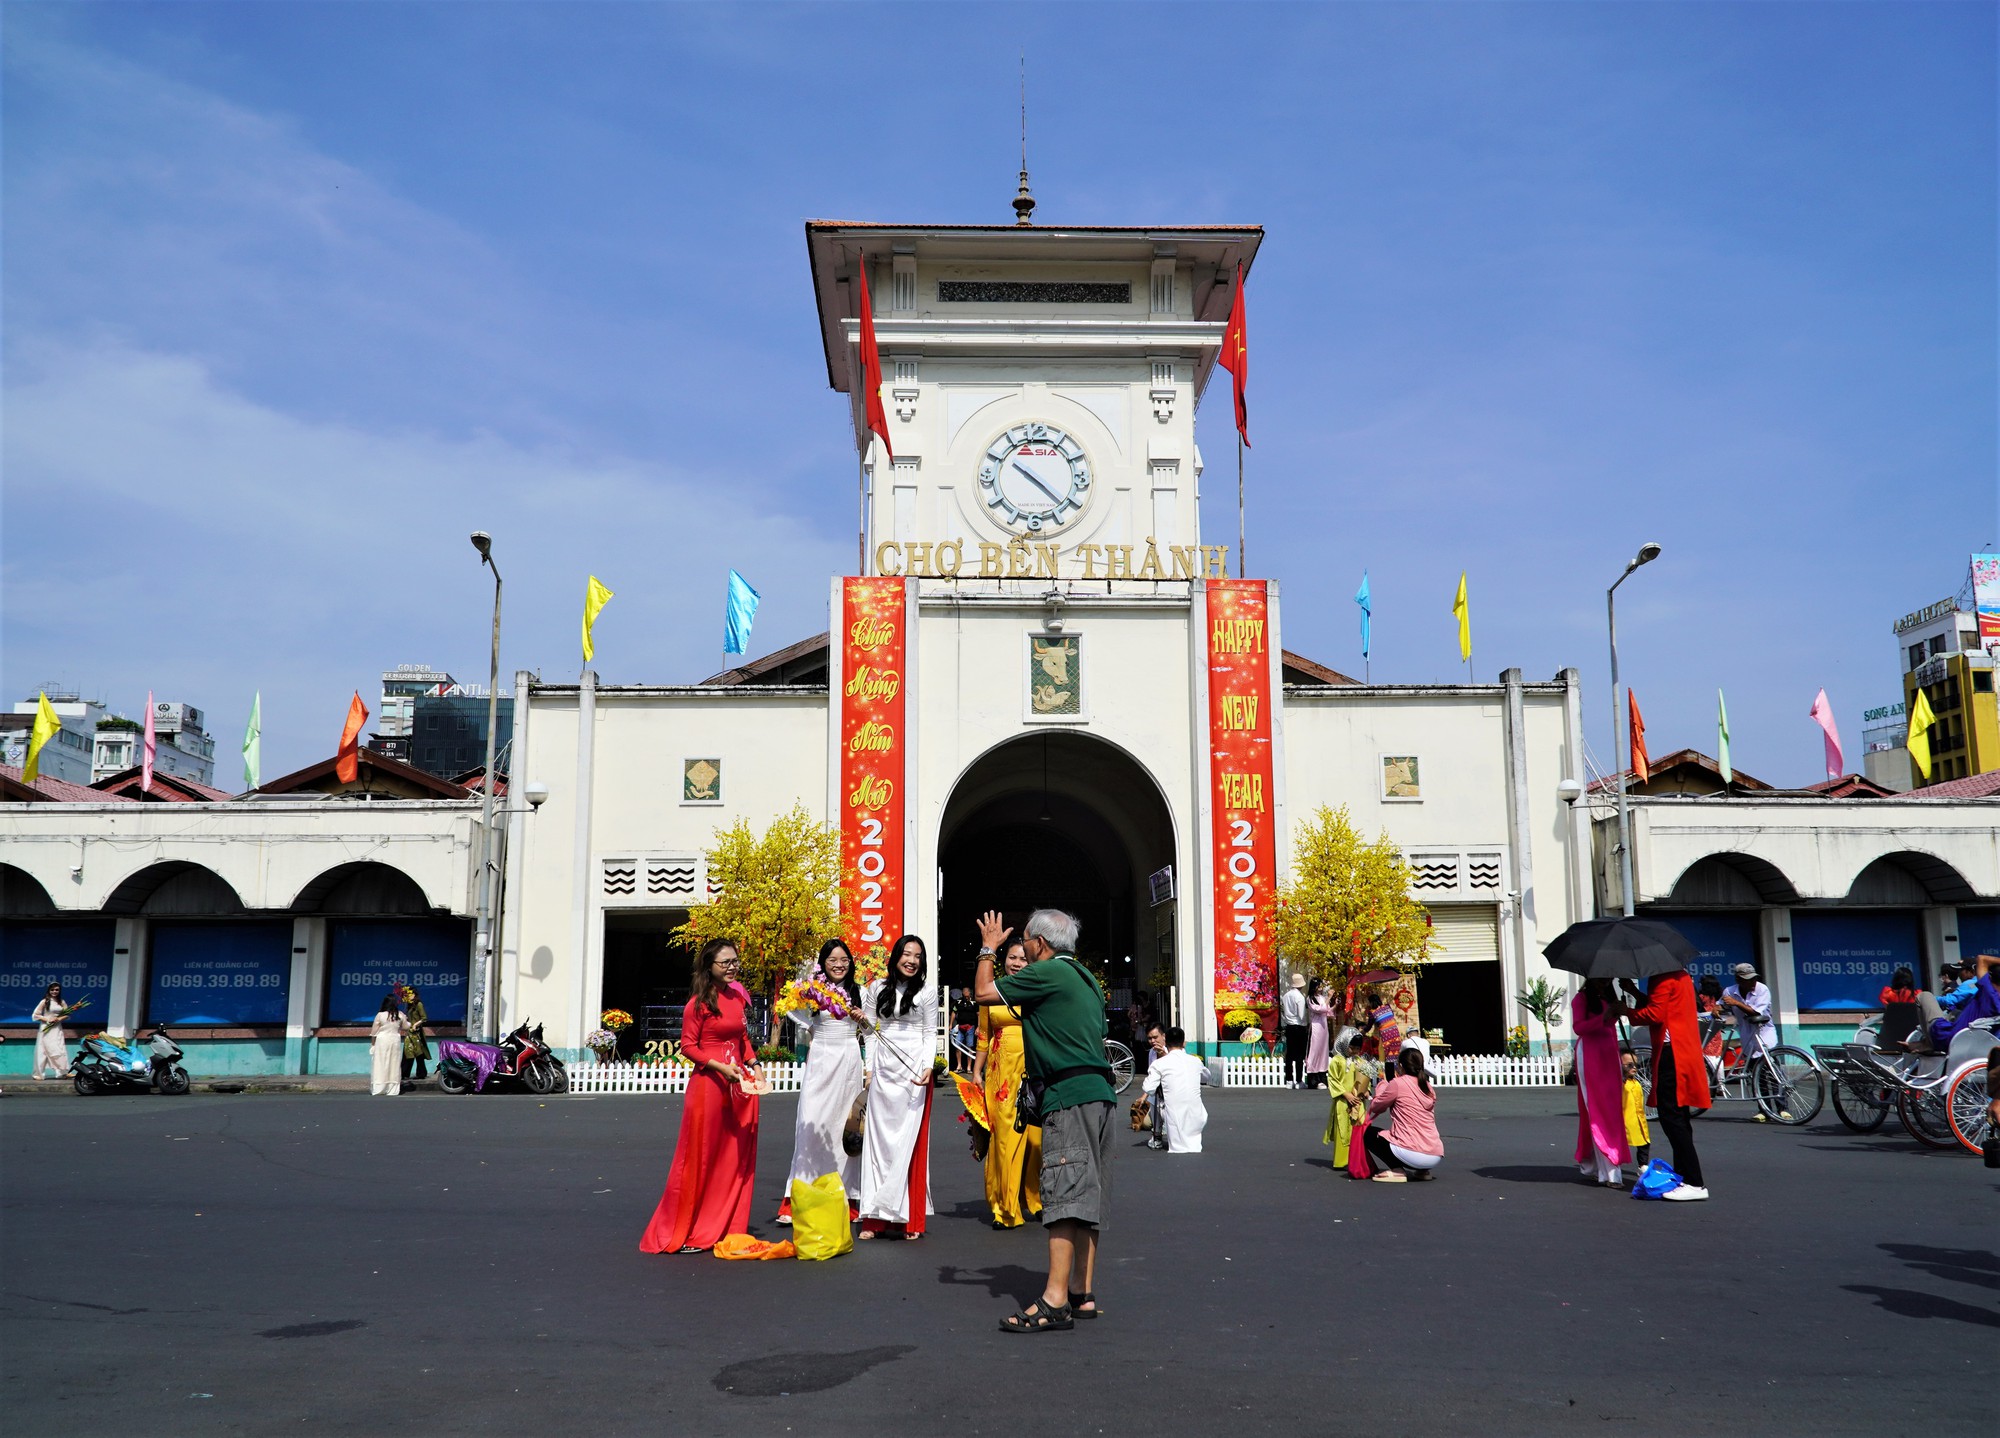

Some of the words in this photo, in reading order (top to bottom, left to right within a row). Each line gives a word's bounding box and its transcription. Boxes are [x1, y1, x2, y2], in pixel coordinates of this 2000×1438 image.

[1023, 422, 1048, 441] 12
[980, 466, 995, 483] 9
[1074, 469, 1090, 486] 3
[1027, 513, 1043, 530] 6
[876, 537, 963, 583] CHỢ
[979, 532, 1061, 577] BẾN
[1076, 536, 1229, 579] THÀNH
[851, 617, 896, 652] Chúc
[1213, 619, 1264, 654] HAPPY
[397, 664, 431, 672] GOLDEN
[425, 683, 481, 696] AVANTI
[846, 664, 900, 703] Mừng
[1222, 695, 1259, 731] NEW
[1864, 706, 1888, 721] SONG
[850, 721, 894, 752] Năm
[849, 775, 894, 811] Mới
[1221, 772, 1265, 813] YEAR
[858, 818, 885, 942] 2023
[1228, 820, 1256, 942] 2023
[0, 974, 108, 988] 969.3989.89
[161, 974, 280, 988] 0969.39.89.89
[341, 972, 460, 987] 0969.39.89.89
